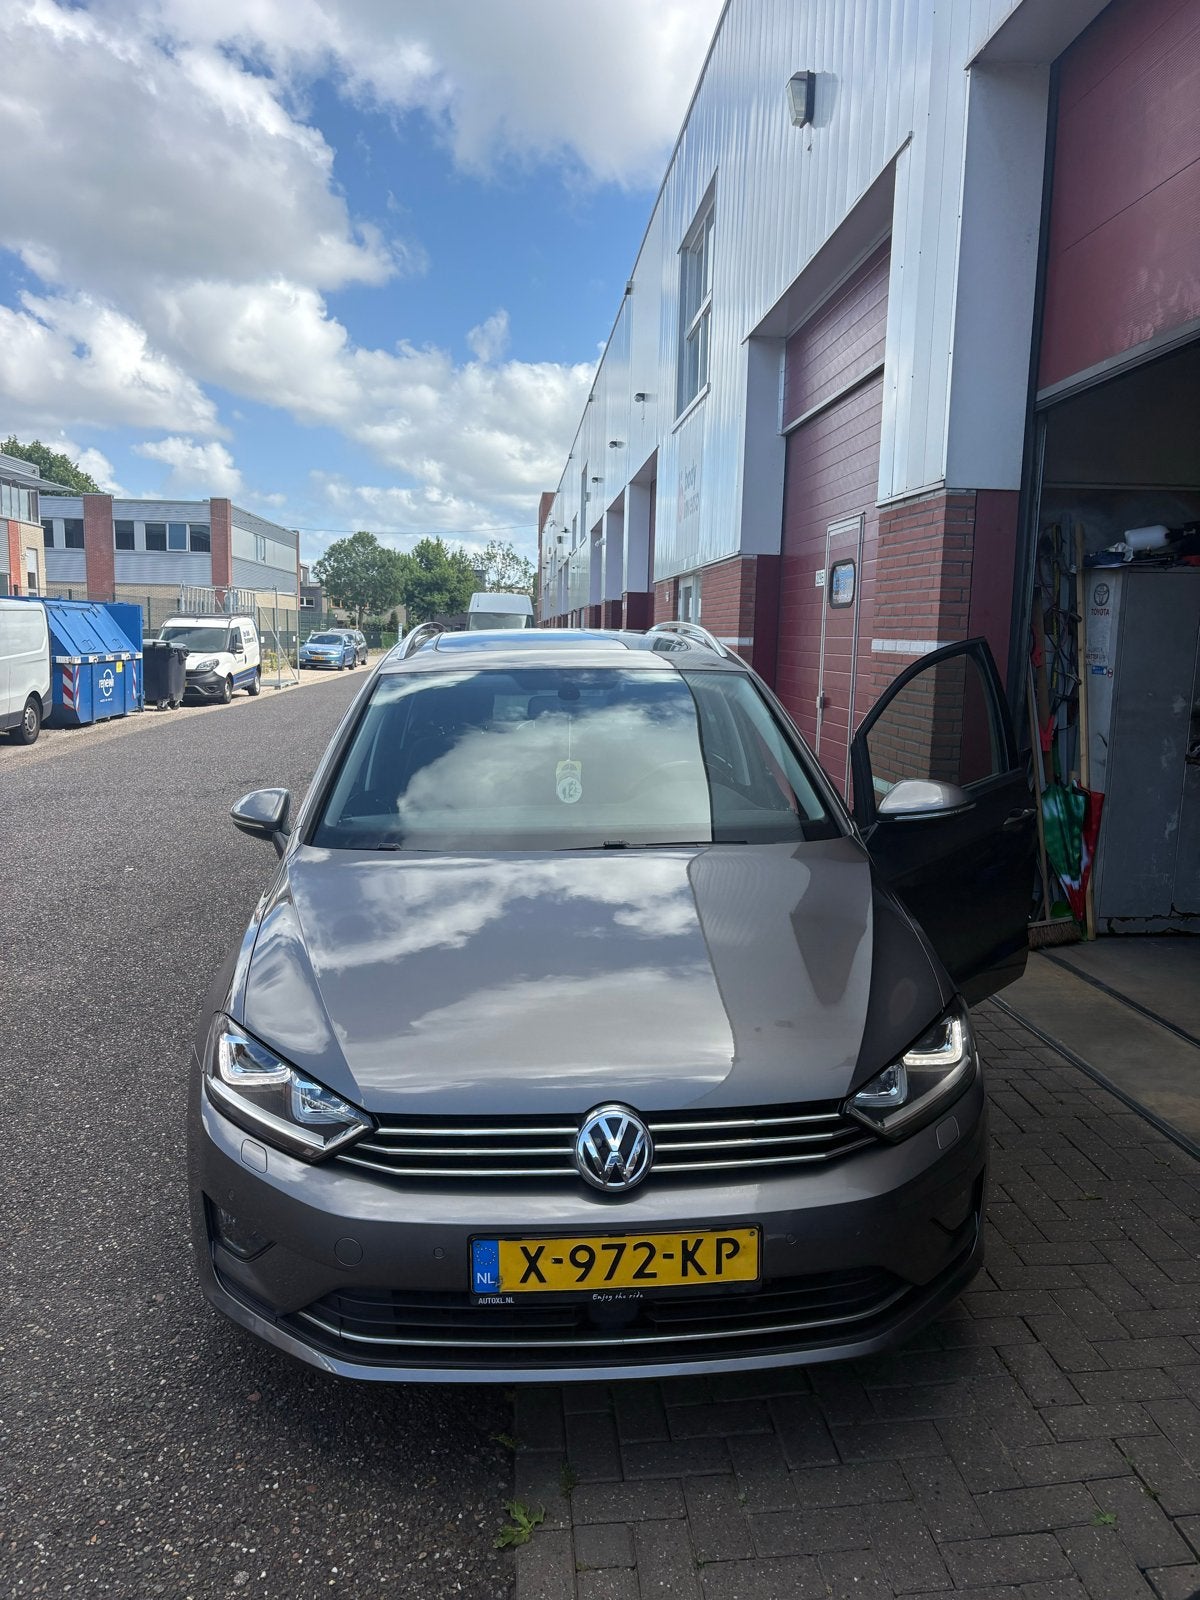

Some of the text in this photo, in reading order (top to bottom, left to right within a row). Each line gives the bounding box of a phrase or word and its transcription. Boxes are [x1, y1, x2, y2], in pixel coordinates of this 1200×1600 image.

[1091, 608, 1110, 616] TOYOTA
[519, 1237, 741, 1285] X-972-KP
[476, 1272, 496, 1285] NL
[478, 1297, 515, 1305] AUTOXL.NL
[592, 1291, 644, 1302] Enjoy the ride
